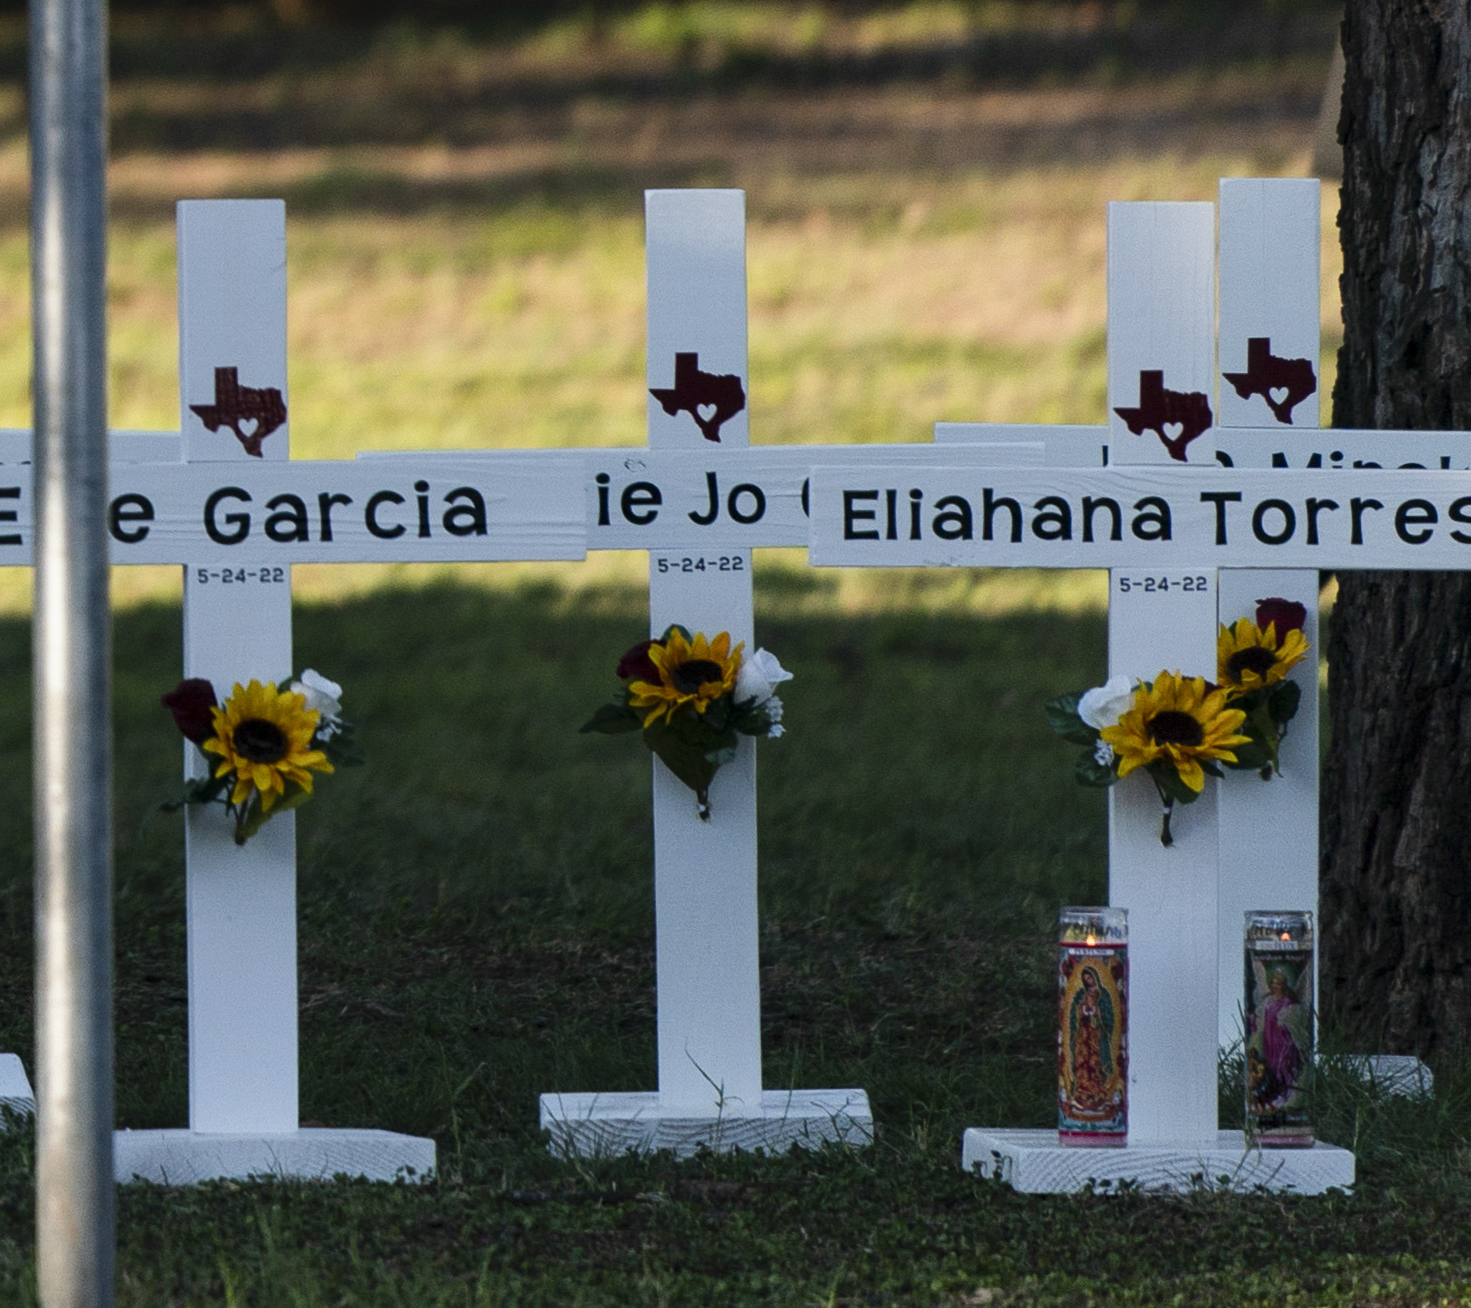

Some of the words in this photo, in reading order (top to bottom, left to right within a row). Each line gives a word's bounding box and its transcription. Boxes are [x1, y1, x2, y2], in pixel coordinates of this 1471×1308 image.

[203, 480, 488, 545] Garcia
[688, 472, 766, 526] Jo
[843, 488, 1174, 544] Eliahana
[1200, 491, 1471, 547] Torres
[197, 567, 285, 584] 5-24-22
[658, 555, 745, 574] 5-24-22
[1120, 577, 1208, 593] 5-24-22
